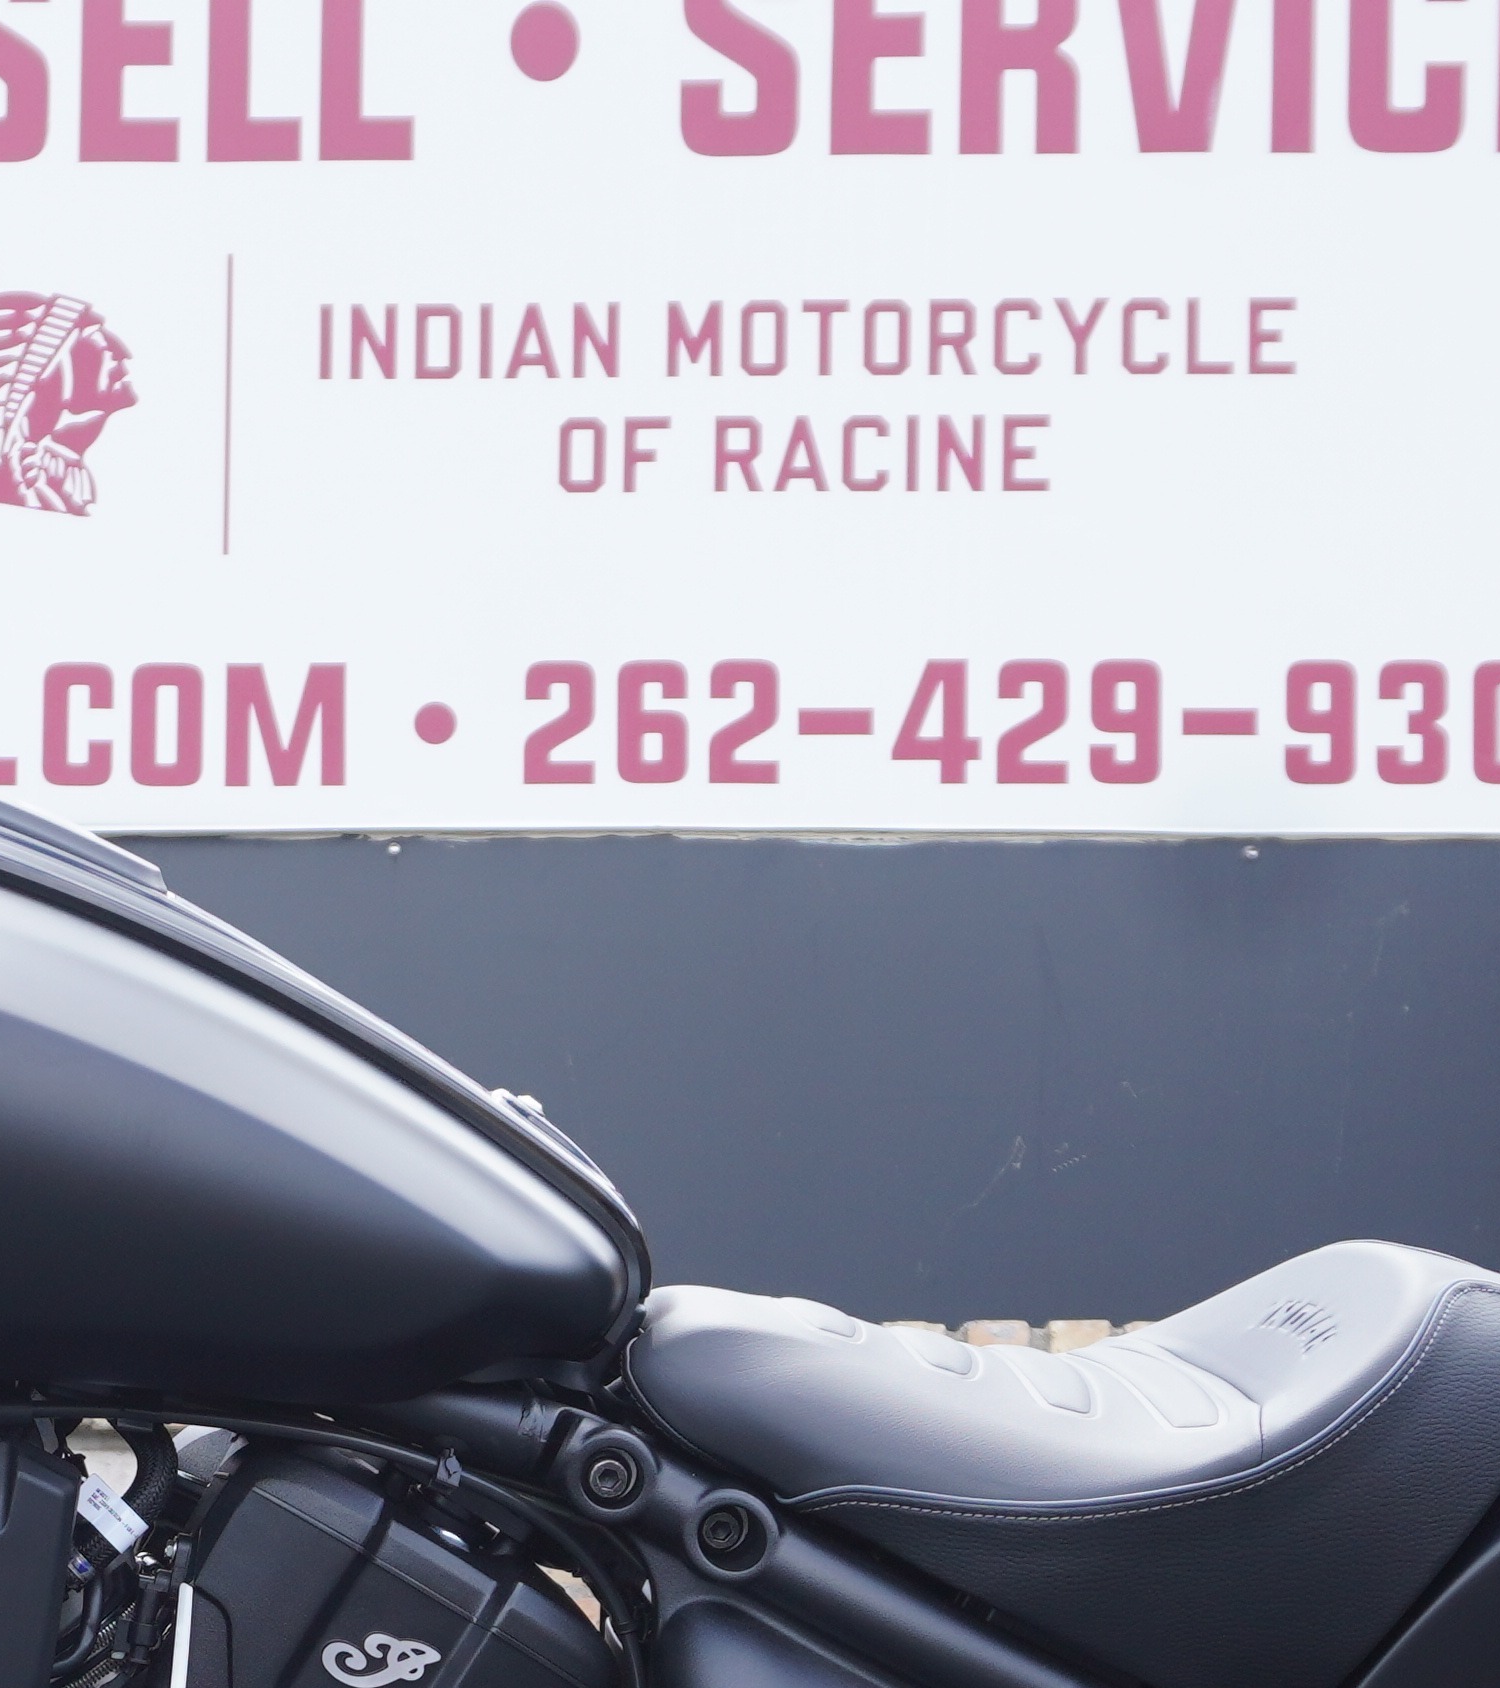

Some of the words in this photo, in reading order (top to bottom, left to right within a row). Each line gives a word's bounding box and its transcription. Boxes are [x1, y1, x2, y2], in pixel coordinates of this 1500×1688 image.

[317, 303, 622, 382] INDIAN
[664, 298, 1297, 380] MOTORCYCLE
[556, 417, 671, 496] OF
[711, 414, 1050, 494] RACINE
